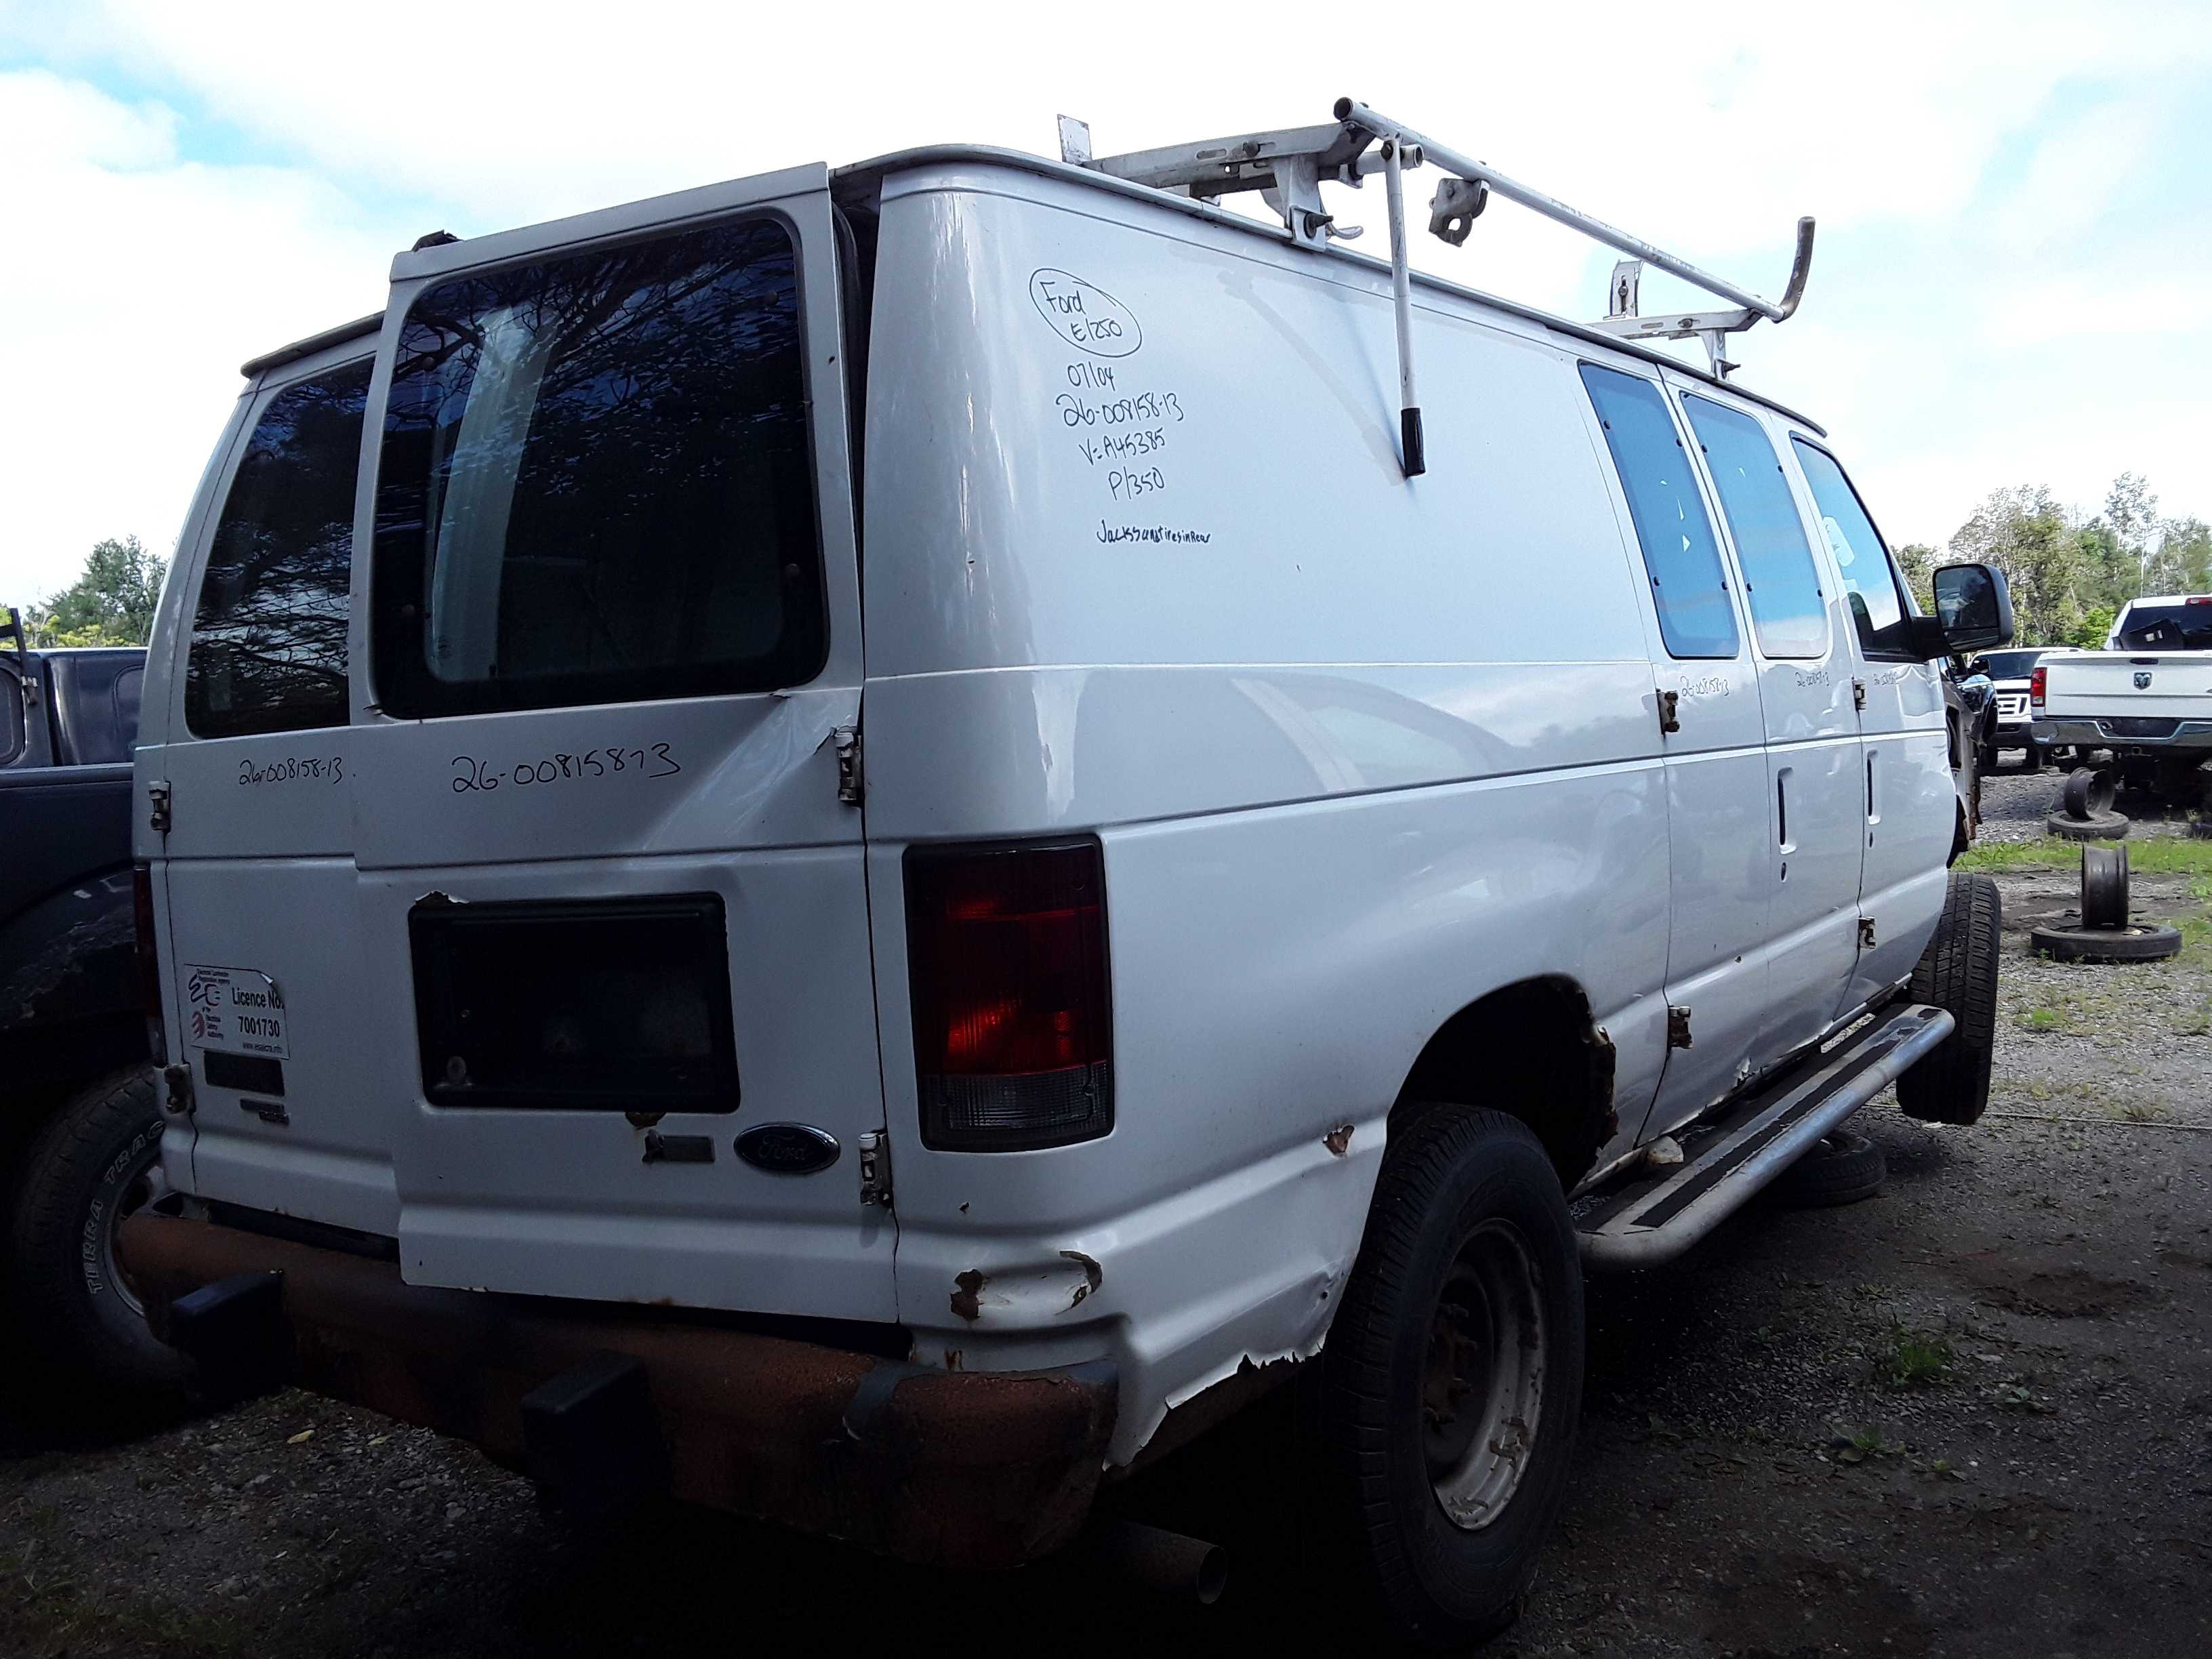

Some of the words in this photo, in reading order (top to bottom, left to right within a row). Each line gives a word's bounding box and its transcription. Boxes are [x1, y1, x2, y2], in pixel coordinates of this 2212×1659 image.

[1040, 281, 1086, 314] Ford
[1108, 466, 1165, 500] P/350
[232, 987, 266, 1008] Licence
[238, 1015, 280, 1038] 7001730
